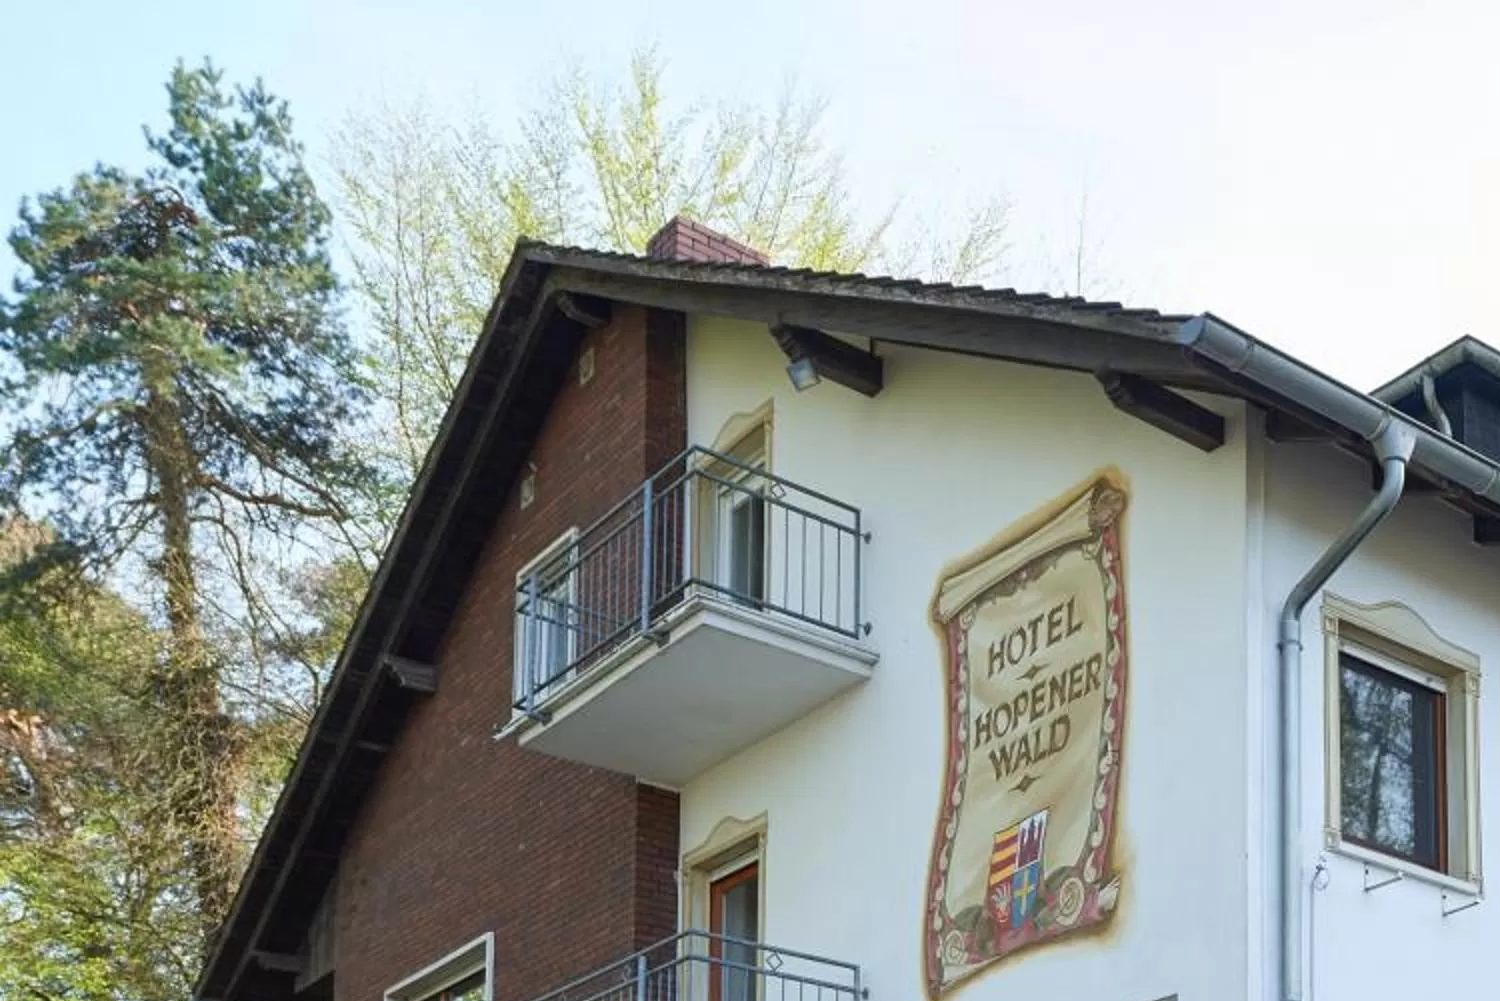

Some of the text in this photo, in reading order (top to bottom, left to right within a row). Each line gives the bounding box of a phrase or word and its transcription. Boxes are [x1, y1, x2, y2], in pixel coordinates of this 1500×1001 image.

[988, 597, 1083, 678] HOTEL
[975, 652, 1102, 750] HOPENER
[988, 715, 1071, 781] WALD
